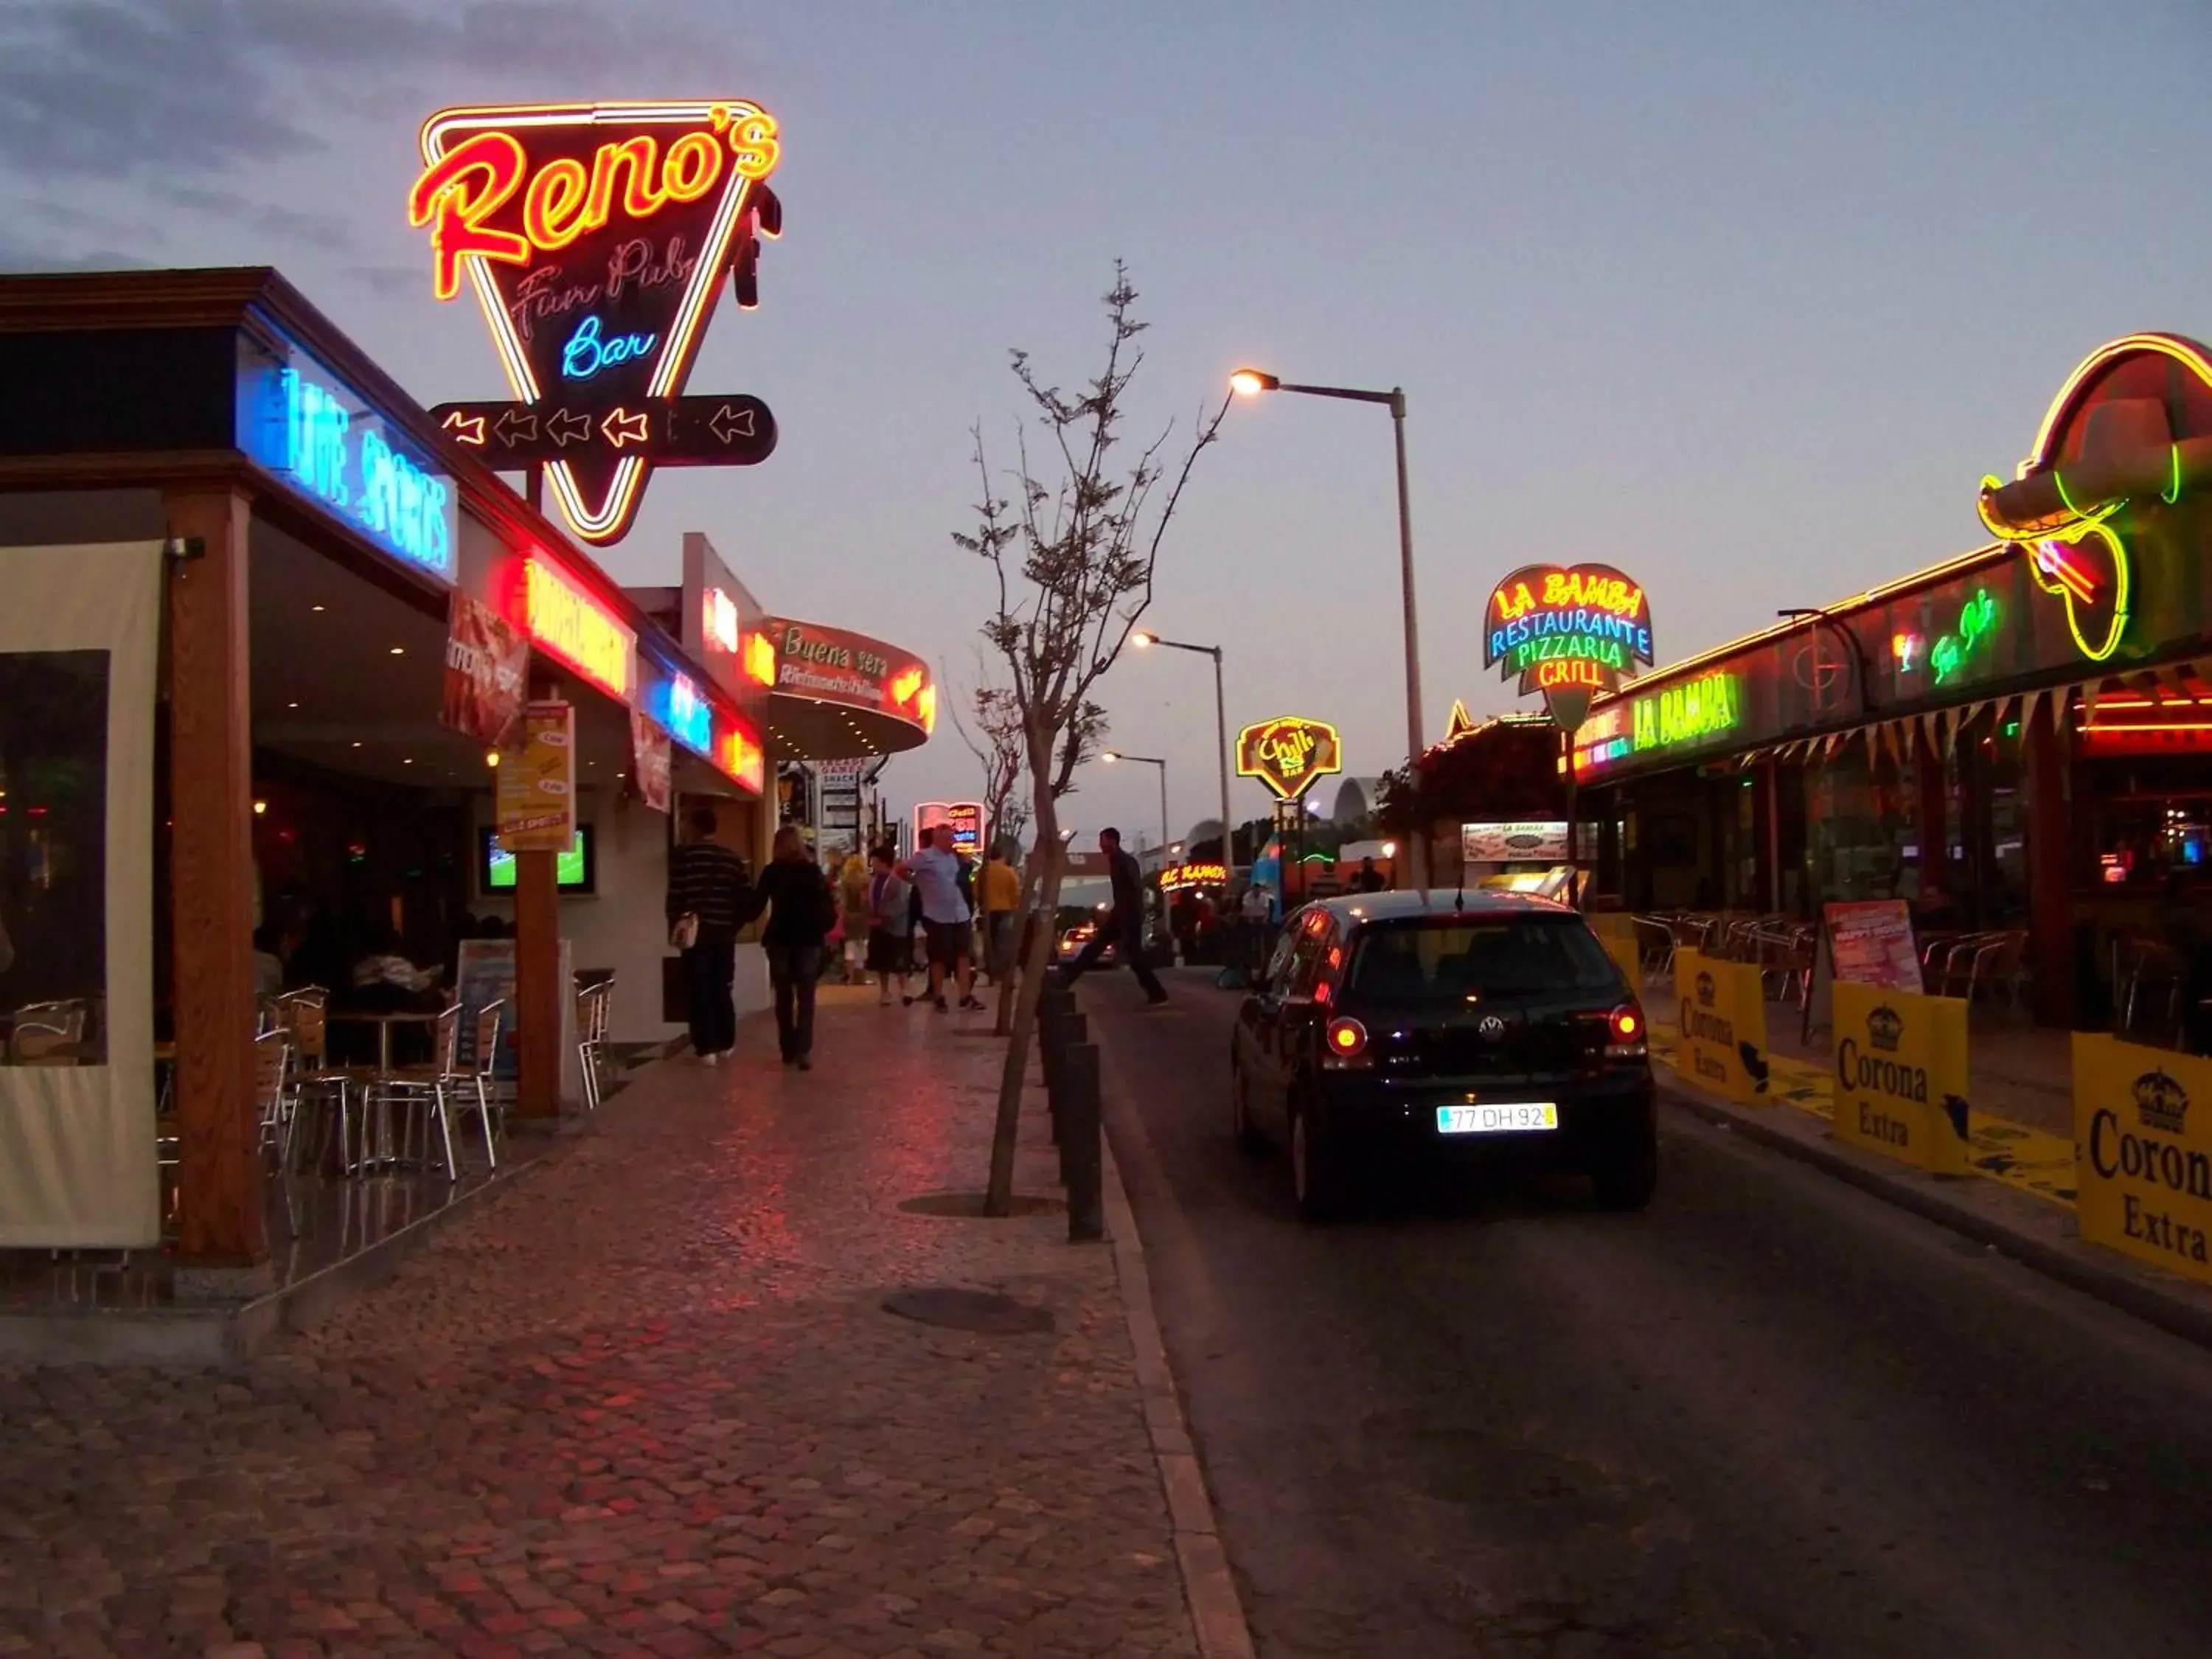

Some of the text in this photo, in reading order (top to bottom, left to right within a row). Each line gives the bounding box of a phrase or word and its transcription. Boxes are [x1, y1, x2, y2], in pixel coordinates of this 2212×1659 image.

[408, 105, 781, 299] Reno's
[562, 316, 658, 377] Bar
[1495, 572, 1643, 620] LA BAMBA
[785, 627, 851, 668] Buena
[1491, 609, 1650, 657] RESTAURANTE
[1517, 635, 1622, 668] PIZZARIA
[1539, 661, 1604, 686] GRILL
[1633, 698, 1658, 752] LA
[1680, 996, 1734, 1048] Corona
[1838, 1037, 1928, 1105] Corona
[1858, 1100, 1909, 1147] Extra
[2123, 1192, 2208, 1264] Extra
